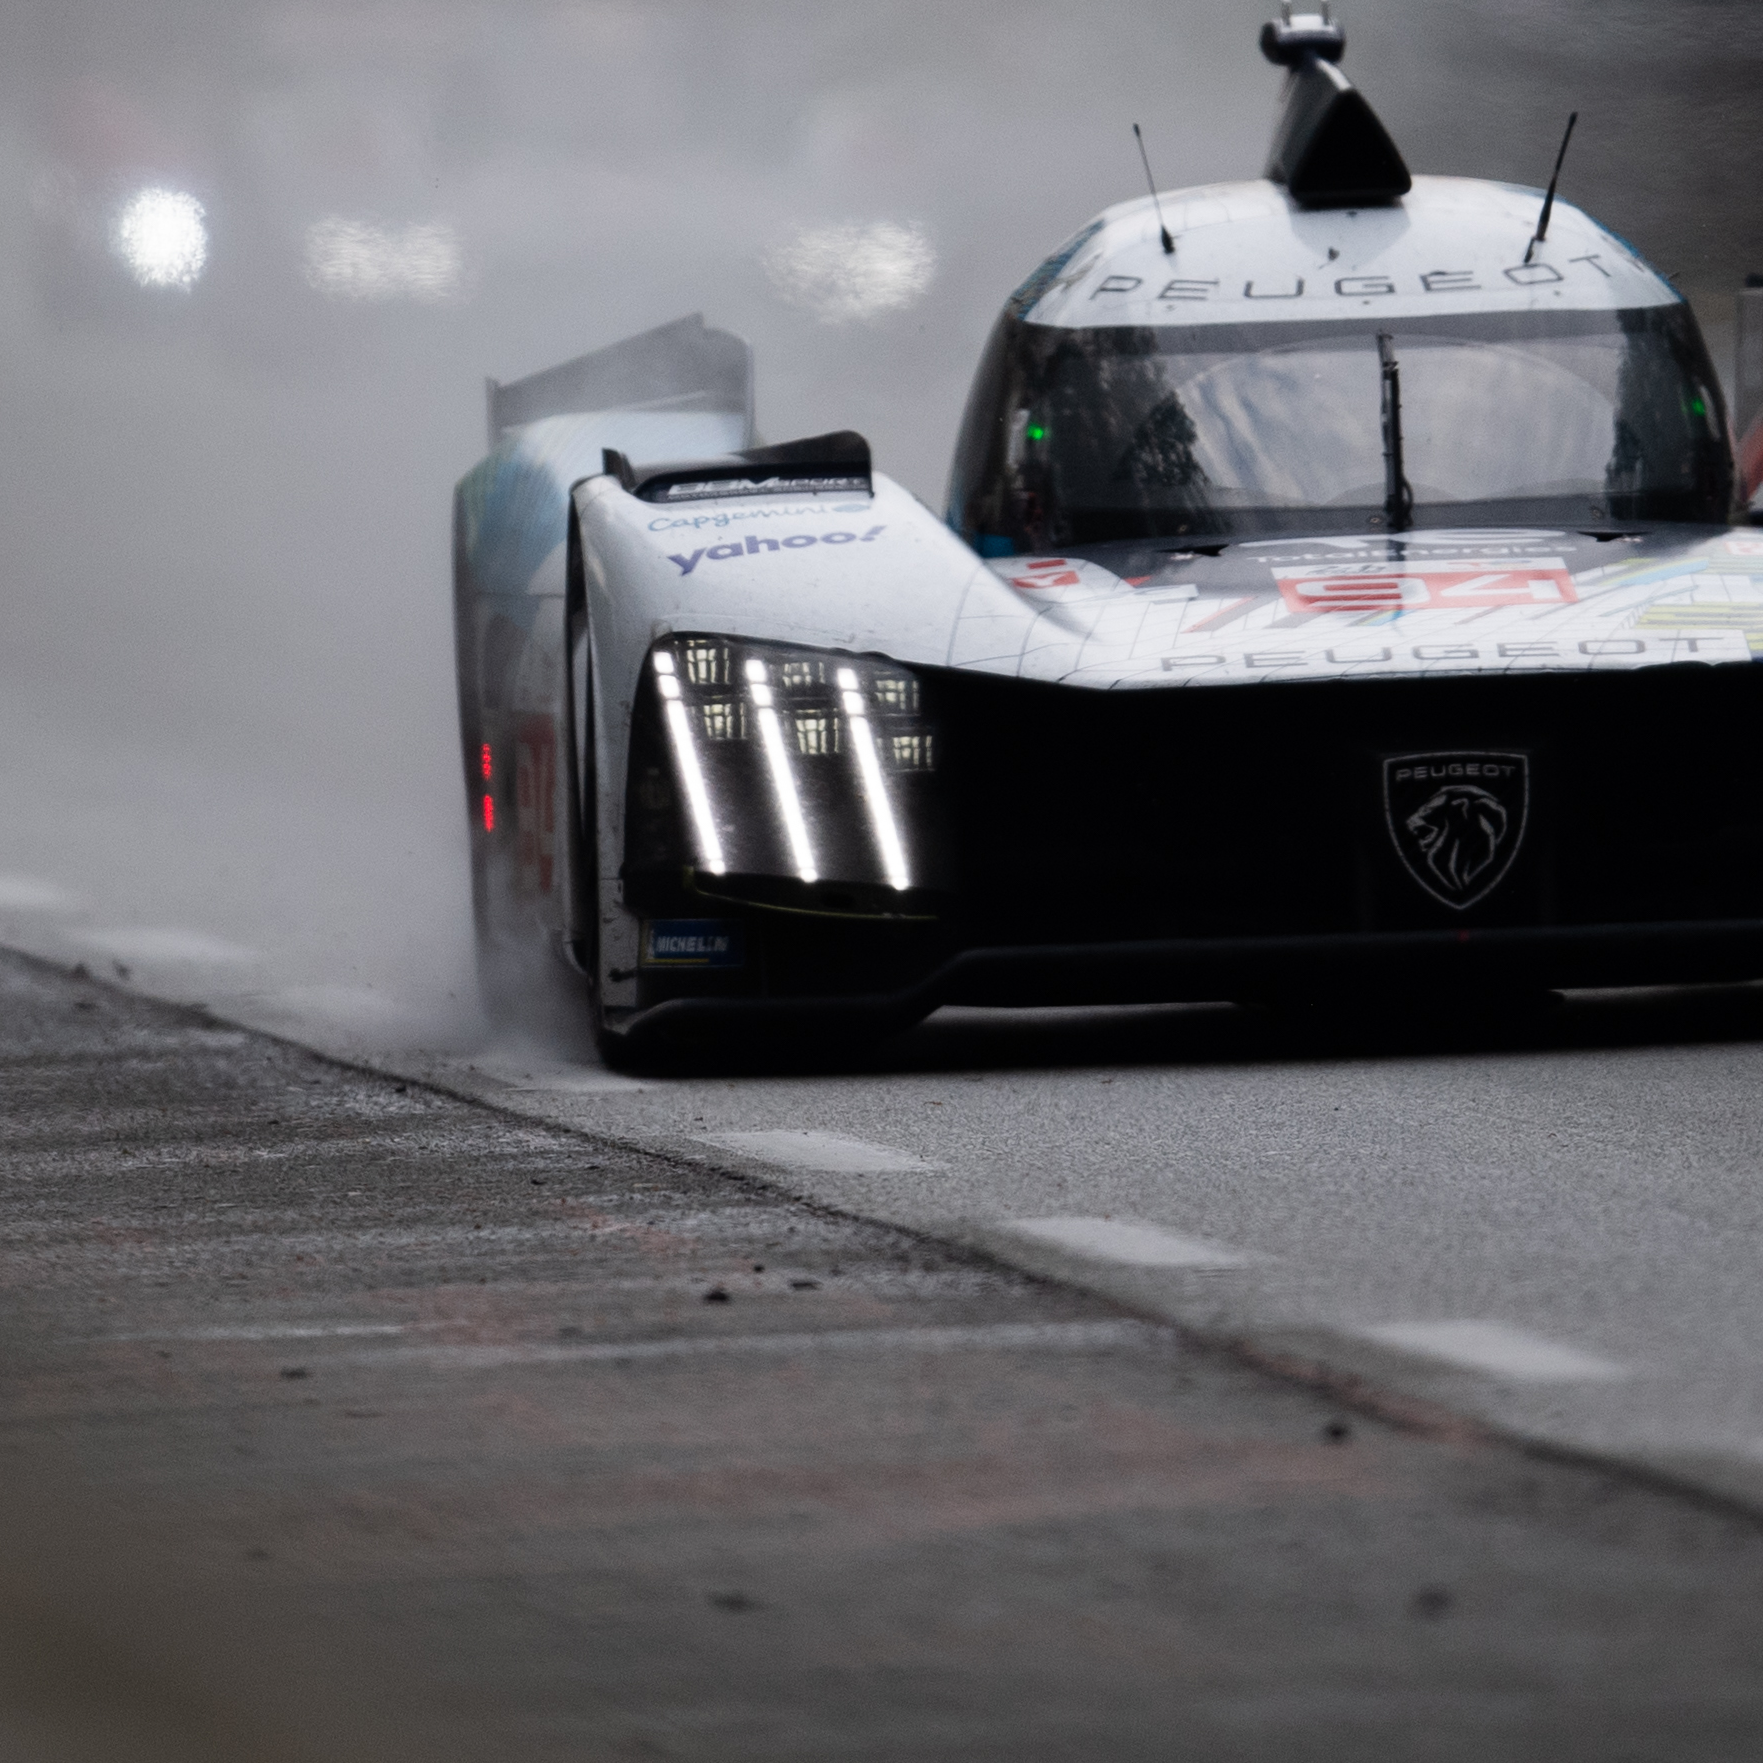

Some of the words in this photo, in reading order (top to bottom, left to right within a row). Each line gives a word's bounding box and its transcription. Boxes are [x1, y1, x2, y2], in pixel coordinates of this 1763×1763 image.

[1088, 254, 1614, 301] PEUGEOT
[647, 504, 828, 531] Capgemini
[667, 525, 887, 576] yahoo!
[1247, 544, 1577, 563] TotalEnergies
[1296, 573, 1562, 608] 94
[1160, 636, 1724, 671] PEUGEOT
[1394, 762, 1516, 783] PEUGEOT
[656, 936, 729, 952] MICHELIN
